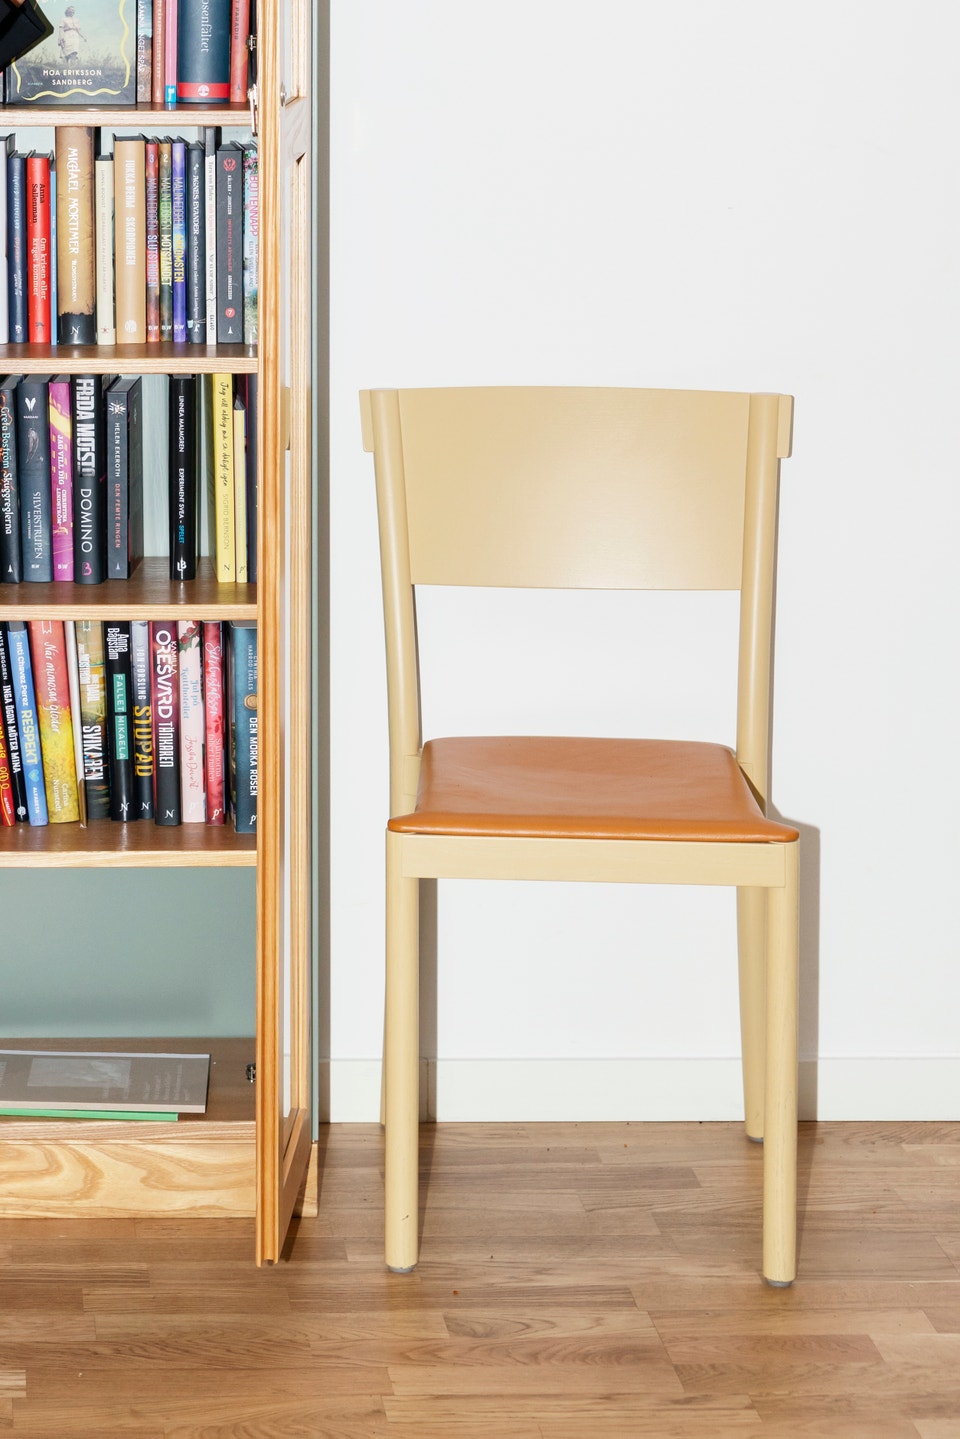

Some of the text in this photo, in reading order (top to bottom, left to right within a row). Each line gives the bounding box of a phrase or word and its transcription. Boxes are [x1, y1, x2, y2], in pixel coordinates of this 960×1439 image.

[38, 183, 46, 204] Anna
[124, 159, 136, 185] JUKKA
[31, 183, 39, 224] Sallenman
[67, 147, 80, 255] MICHAEL MORTIMER
[147, 176, 157, 231] MALIN EDGREN
[160, 176, 171, 231] MALIN EDGREN
[173, 176, 184, 231] MALIN EDGREN
[31, 237, 41, 297] kriget kommer
[40, 237, 47, 252] Om
[40, 253, 48, 278] krisen
[124, 216, 136, 266] SKORPIONEN
[147, 234, 158, 288] SLUTSTRIDEN
[57, 434, 65, 450] JAG
[114, 446, 122, 477] EKEROTH
[0, 406, 13, 535] Greta Boström Skuggreglerna
[58, 470, 66, 485] DIG
[32, 491, 43, 560] SILVERSTRUPEN
[79, 488, 93, 554] DOMINO
[0, 647, 8, 681] BERGGREN
[118, 633, 130, 653] Anna
[15, 641, 25, 655] Inti
[20, 685, 29, 707] Perez
[2, 684, 21, 774] INGA ÖGON MÖTER MINA
[20, 709, 39, 765] RESPEKT
[114, 673, 128, 760] FALLET MIKAELA
[132, 704, 154, 778] STUPAD
[81, 724, 104, 781] SVIKAREN
[158, 720, 175, 768] TÄNKAREN
[52, 779, 62, 812] Nunstedt
